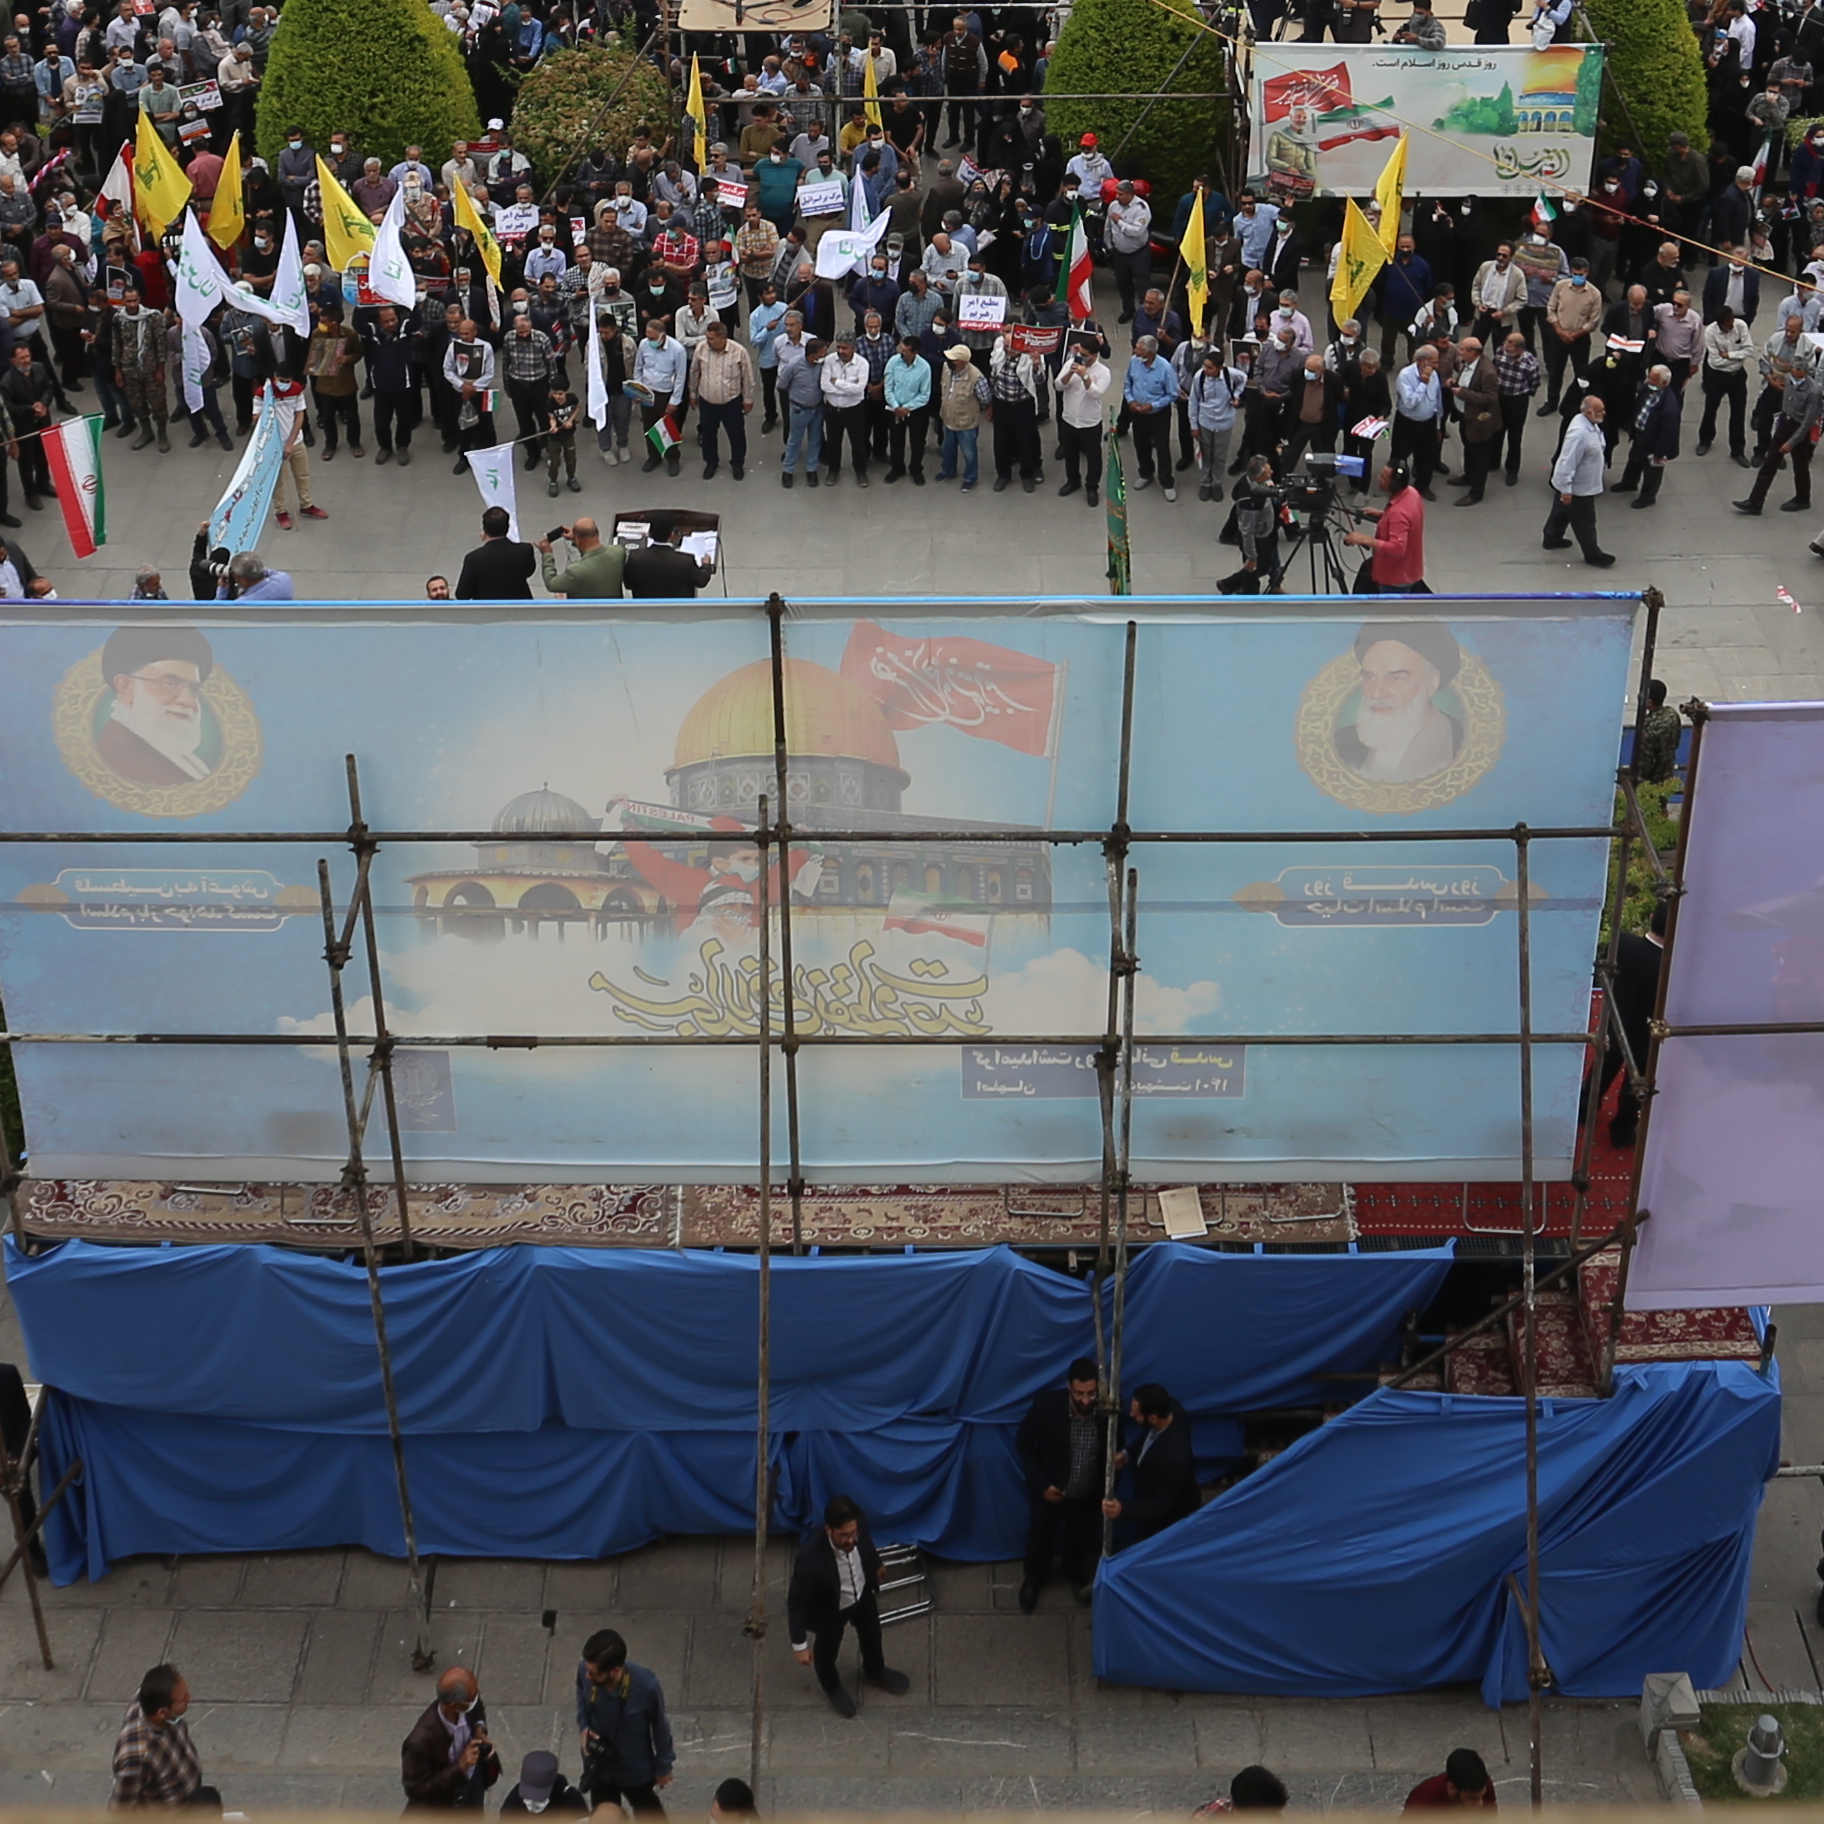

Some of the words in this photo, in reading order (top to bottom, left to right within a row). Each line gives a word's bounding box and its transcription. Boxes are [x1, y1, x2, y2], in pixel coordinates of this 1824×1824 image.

[1372, 58, 1400, 67] است.
[1401, 58, 1435, 70] اسلام
[1436, 59, 1451, 70] روز
[1452, 58, 1481, 70] قدس
[1483, 59, 1497, 70] روز
[801, 195, 822, 206] اسرائیل
[829, 192, 841, 200] مرگ
[501, 211, 513, 222] امر
[514, 209, 532, 221] مطیع
[505, 222, 529, 231] رهبریم
[966, 297, 979, 308] امر
[980, 298, 999, 308] مطیع
[969, 310, 994, 320] رهبریم
[1013, 329, 1059, 340] فلسطین
